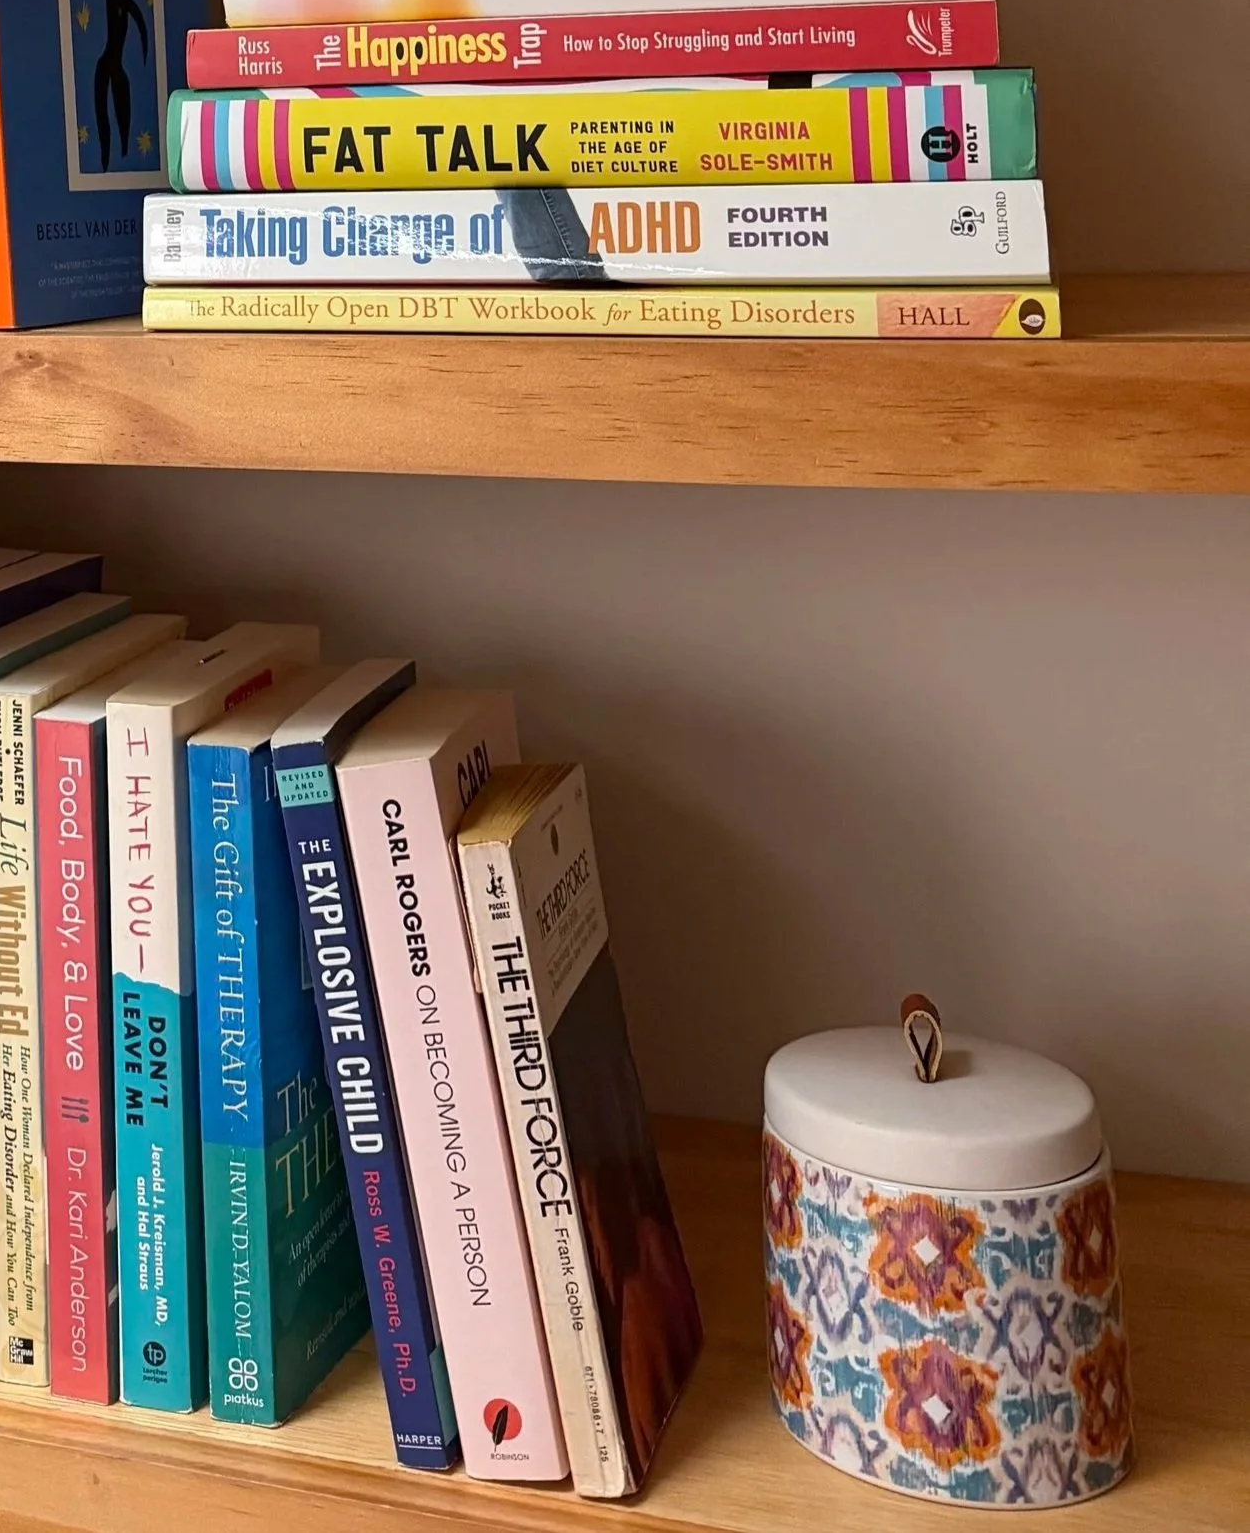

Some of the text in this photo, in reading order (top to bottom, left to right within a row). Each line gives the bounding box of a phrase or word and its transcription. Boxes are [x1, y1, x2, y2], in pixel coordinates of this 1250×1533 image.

[238, 36, 270, 55] Russ
[314, 22, 547, 77] The Happiness Trap
[563, 27, 856, 53] How to Stop Struggling and Start Living
[238, 55, 283, 75] Harris
[718, 121, 810, 141] VIRGINIA
[303, 123, 551, 174] FAT TALK
[966, 123, 979, 165] HOLT
[699, 153, 833, 172] SOLE-SMITH
[727, 207, 827, 224] FOURTH
[199, 201, 701, 265] Taking Charge of ADHD
[728, 231, 829, 248] EDITION
[221, 296, 855, 328] Radically Open DBT Workbook for Eating Disorders
[897, 307, 970, 326] HALL
[281, 770, 324, 782] REVISED
[295, 781, 314, 791] AND
[284, 790, 328, 802] UPDATED
[126, 727, 155, 937] I HATE YOU
[382, 798, 431, 978] CARL ROGERS
[56, 756, 88, 1071] Food, Body, & Love
[488, 903, 511, 912] POCKET
[491, 912, 511, 921] BOOKS
[212, 774, 248, 1122] The Gift of THERAPY
[297, 839, 384, 1154] THE EXPLOSIVE CHILD
[122, 991, 144, 1127] LEAVE ME
[148, 1016, 169, 1108] DON'T
[491, 935, 574, 1218] THE THIRD FORCE
[555, 1227, 584, 1333] Frank Goble
[224, 1392, 264, 1408] piatkus
[396, 1433, 442, 1445] HARPER
[490, 1452, 529, 1461] ROBINSON
